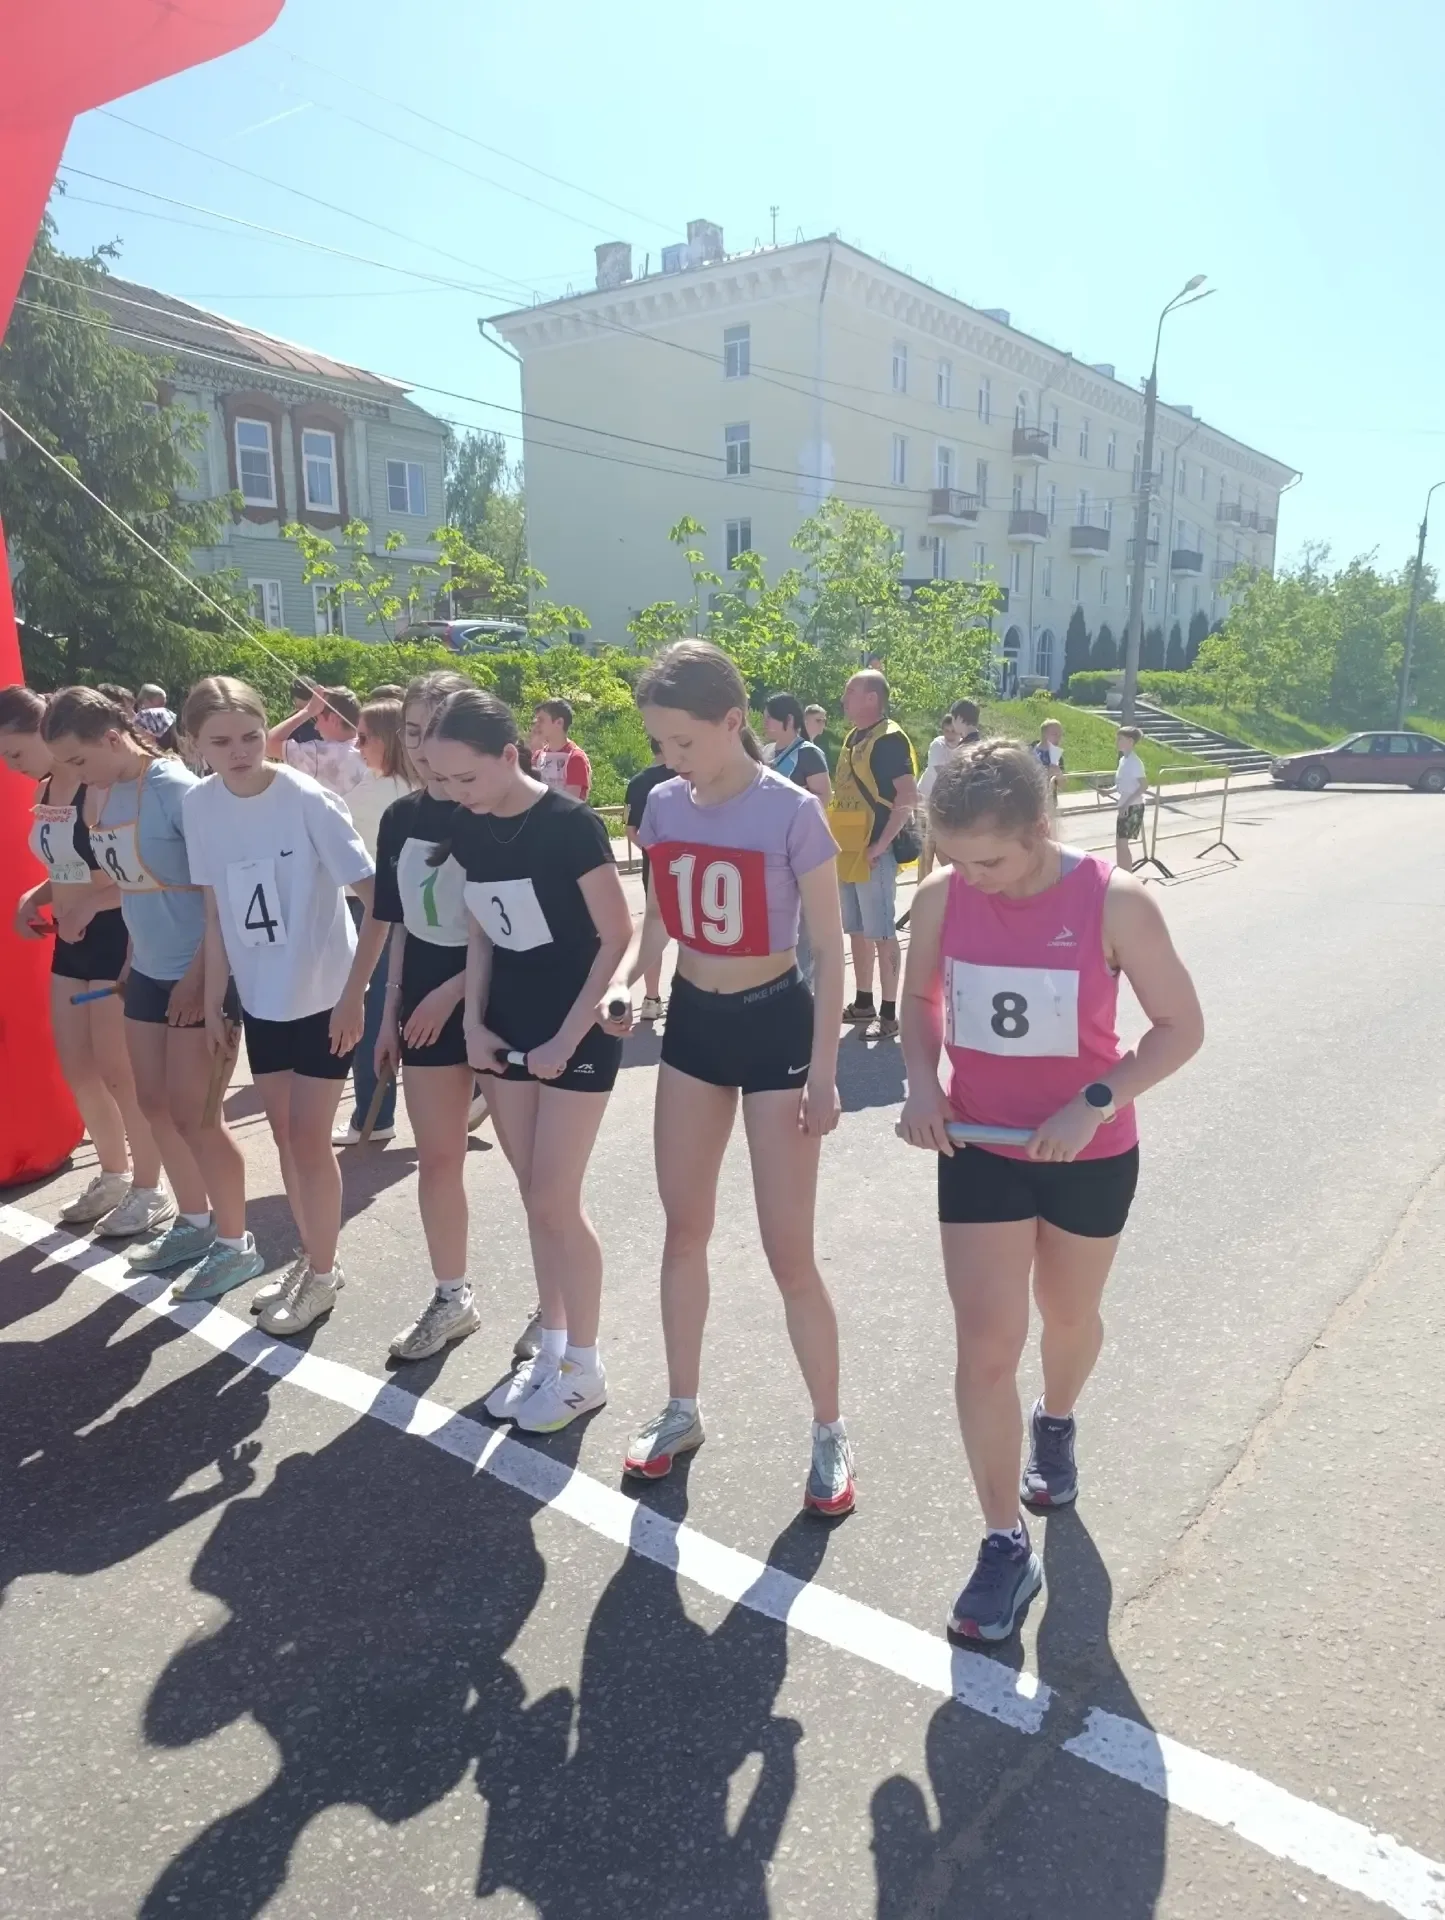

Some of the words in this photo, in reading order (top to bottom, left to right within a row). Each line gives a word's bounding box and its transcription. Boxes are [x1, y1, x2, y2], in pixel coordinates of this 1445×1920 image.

[40, 823, 55, 864] 6
[244, 883, 279, 943] 4
[419, 867, 443, 928] 1
[491, 896, 512, 936] 3
[669, 853, 744, 946] 19
[743, 987, 769, 1004] NIKE
[769, 978, 790, 996] PRO
[990, 991, 1030, 1039] 8
